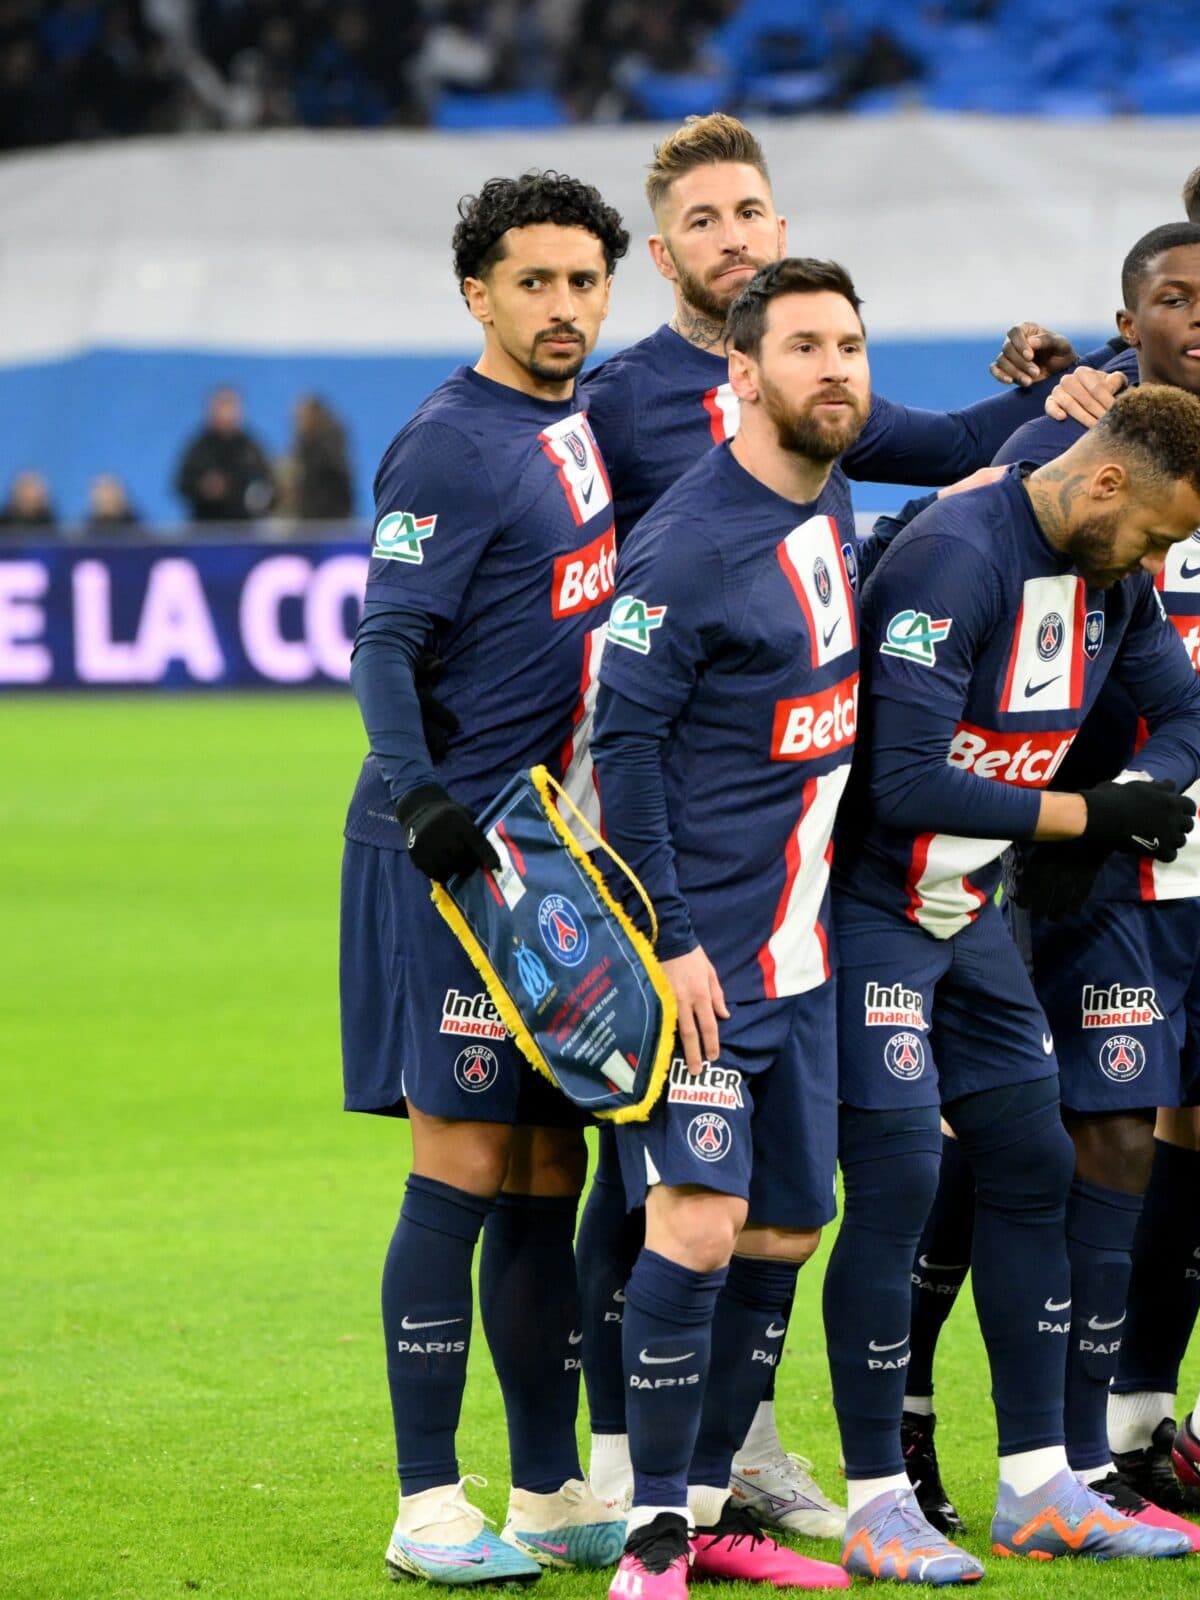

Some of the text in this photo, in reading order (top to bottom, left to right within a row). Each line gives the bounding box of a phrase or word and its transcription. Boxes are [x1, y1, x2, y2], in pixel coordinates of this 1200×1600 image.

[73, 559, 226, 683] LA
[779, 684, 859, 754] Betcl
[541, 899, 563, 925] PARIS
[444, 991, 502, 1021] Inte
[1106, 1038, 1137, 1049] PARIS
[464, 1047, 492, 1061] PARIS
[696, 1116, 725, 1129] PARIS
[1038, 1321, 1071, 1333] PAR
[398, 1341, 465, 1354] PARIS
[630, 1374, 699, 1389] PARIS
